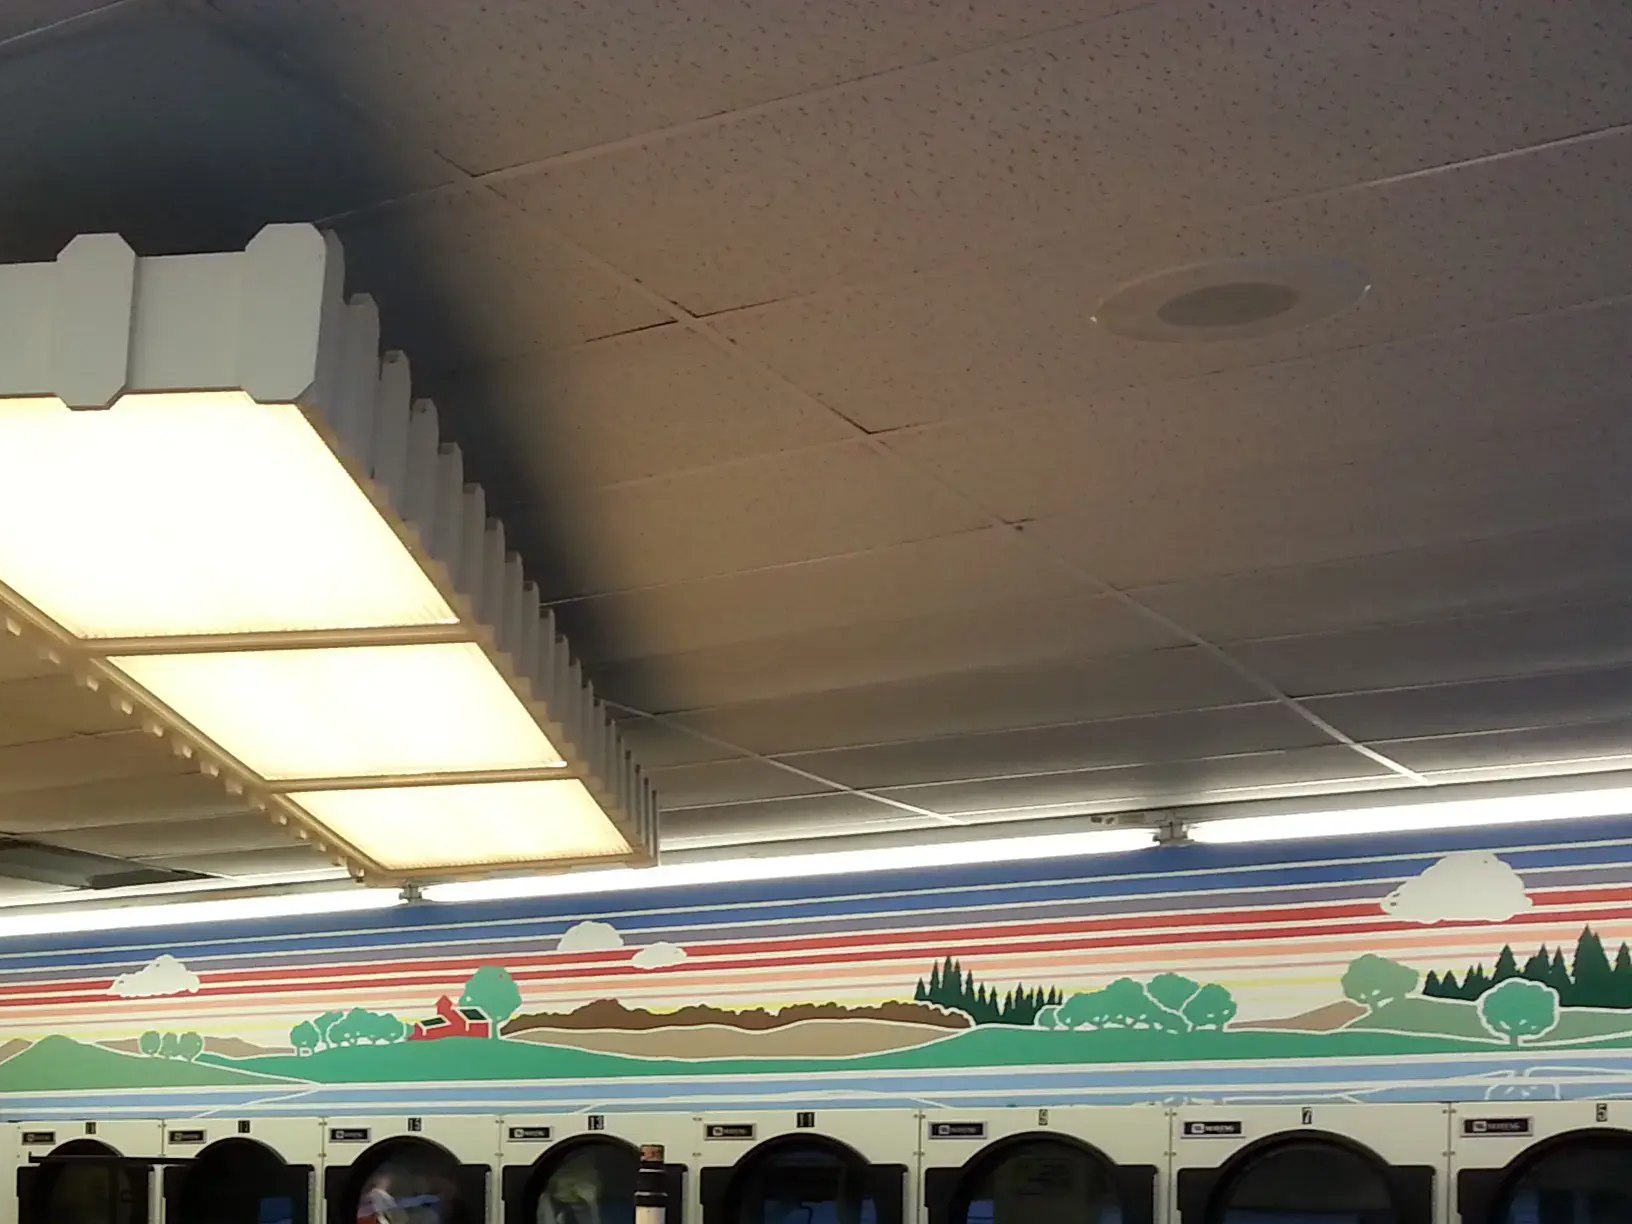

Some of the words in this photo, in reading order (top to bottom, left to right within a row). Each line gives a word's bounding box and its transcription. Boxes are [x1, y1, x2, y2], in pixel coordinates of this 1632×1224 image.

[1302, 1107, 1312, 1124] 7
[1597, 1104, 1607, 1121] 5
[409, 1118, 421, 1131] 15
[590, 1115, 604, 1130] 13
